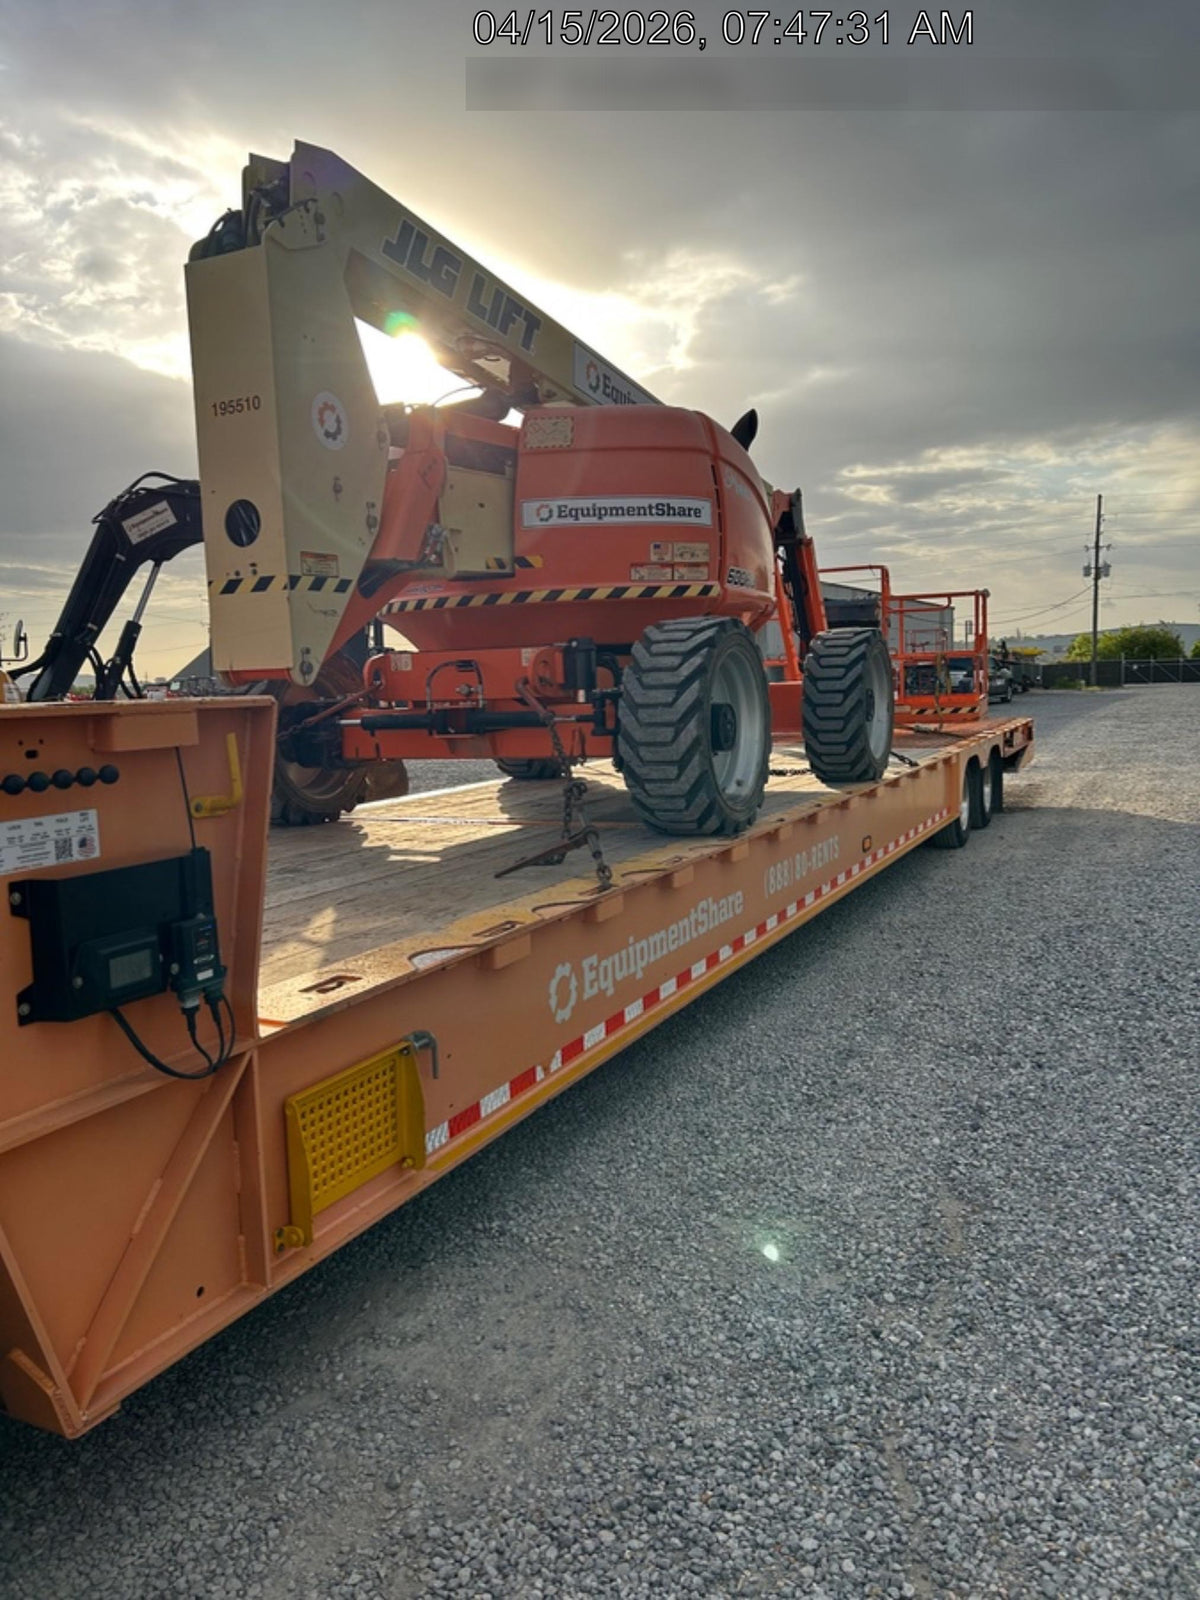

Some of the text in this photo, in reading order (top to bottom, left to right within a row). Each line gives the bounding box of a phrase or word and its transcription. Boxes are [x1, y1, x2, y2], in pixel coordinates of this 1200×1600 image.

[381, 219, 542, 355] JLG LIFT
[602, 373, 637, 405] Equi
[211, 395, 261, 417] 195510
[557, 502, 702, 521] EquipmentShare
[581, 890, 744, 1001] EquipmentShare
